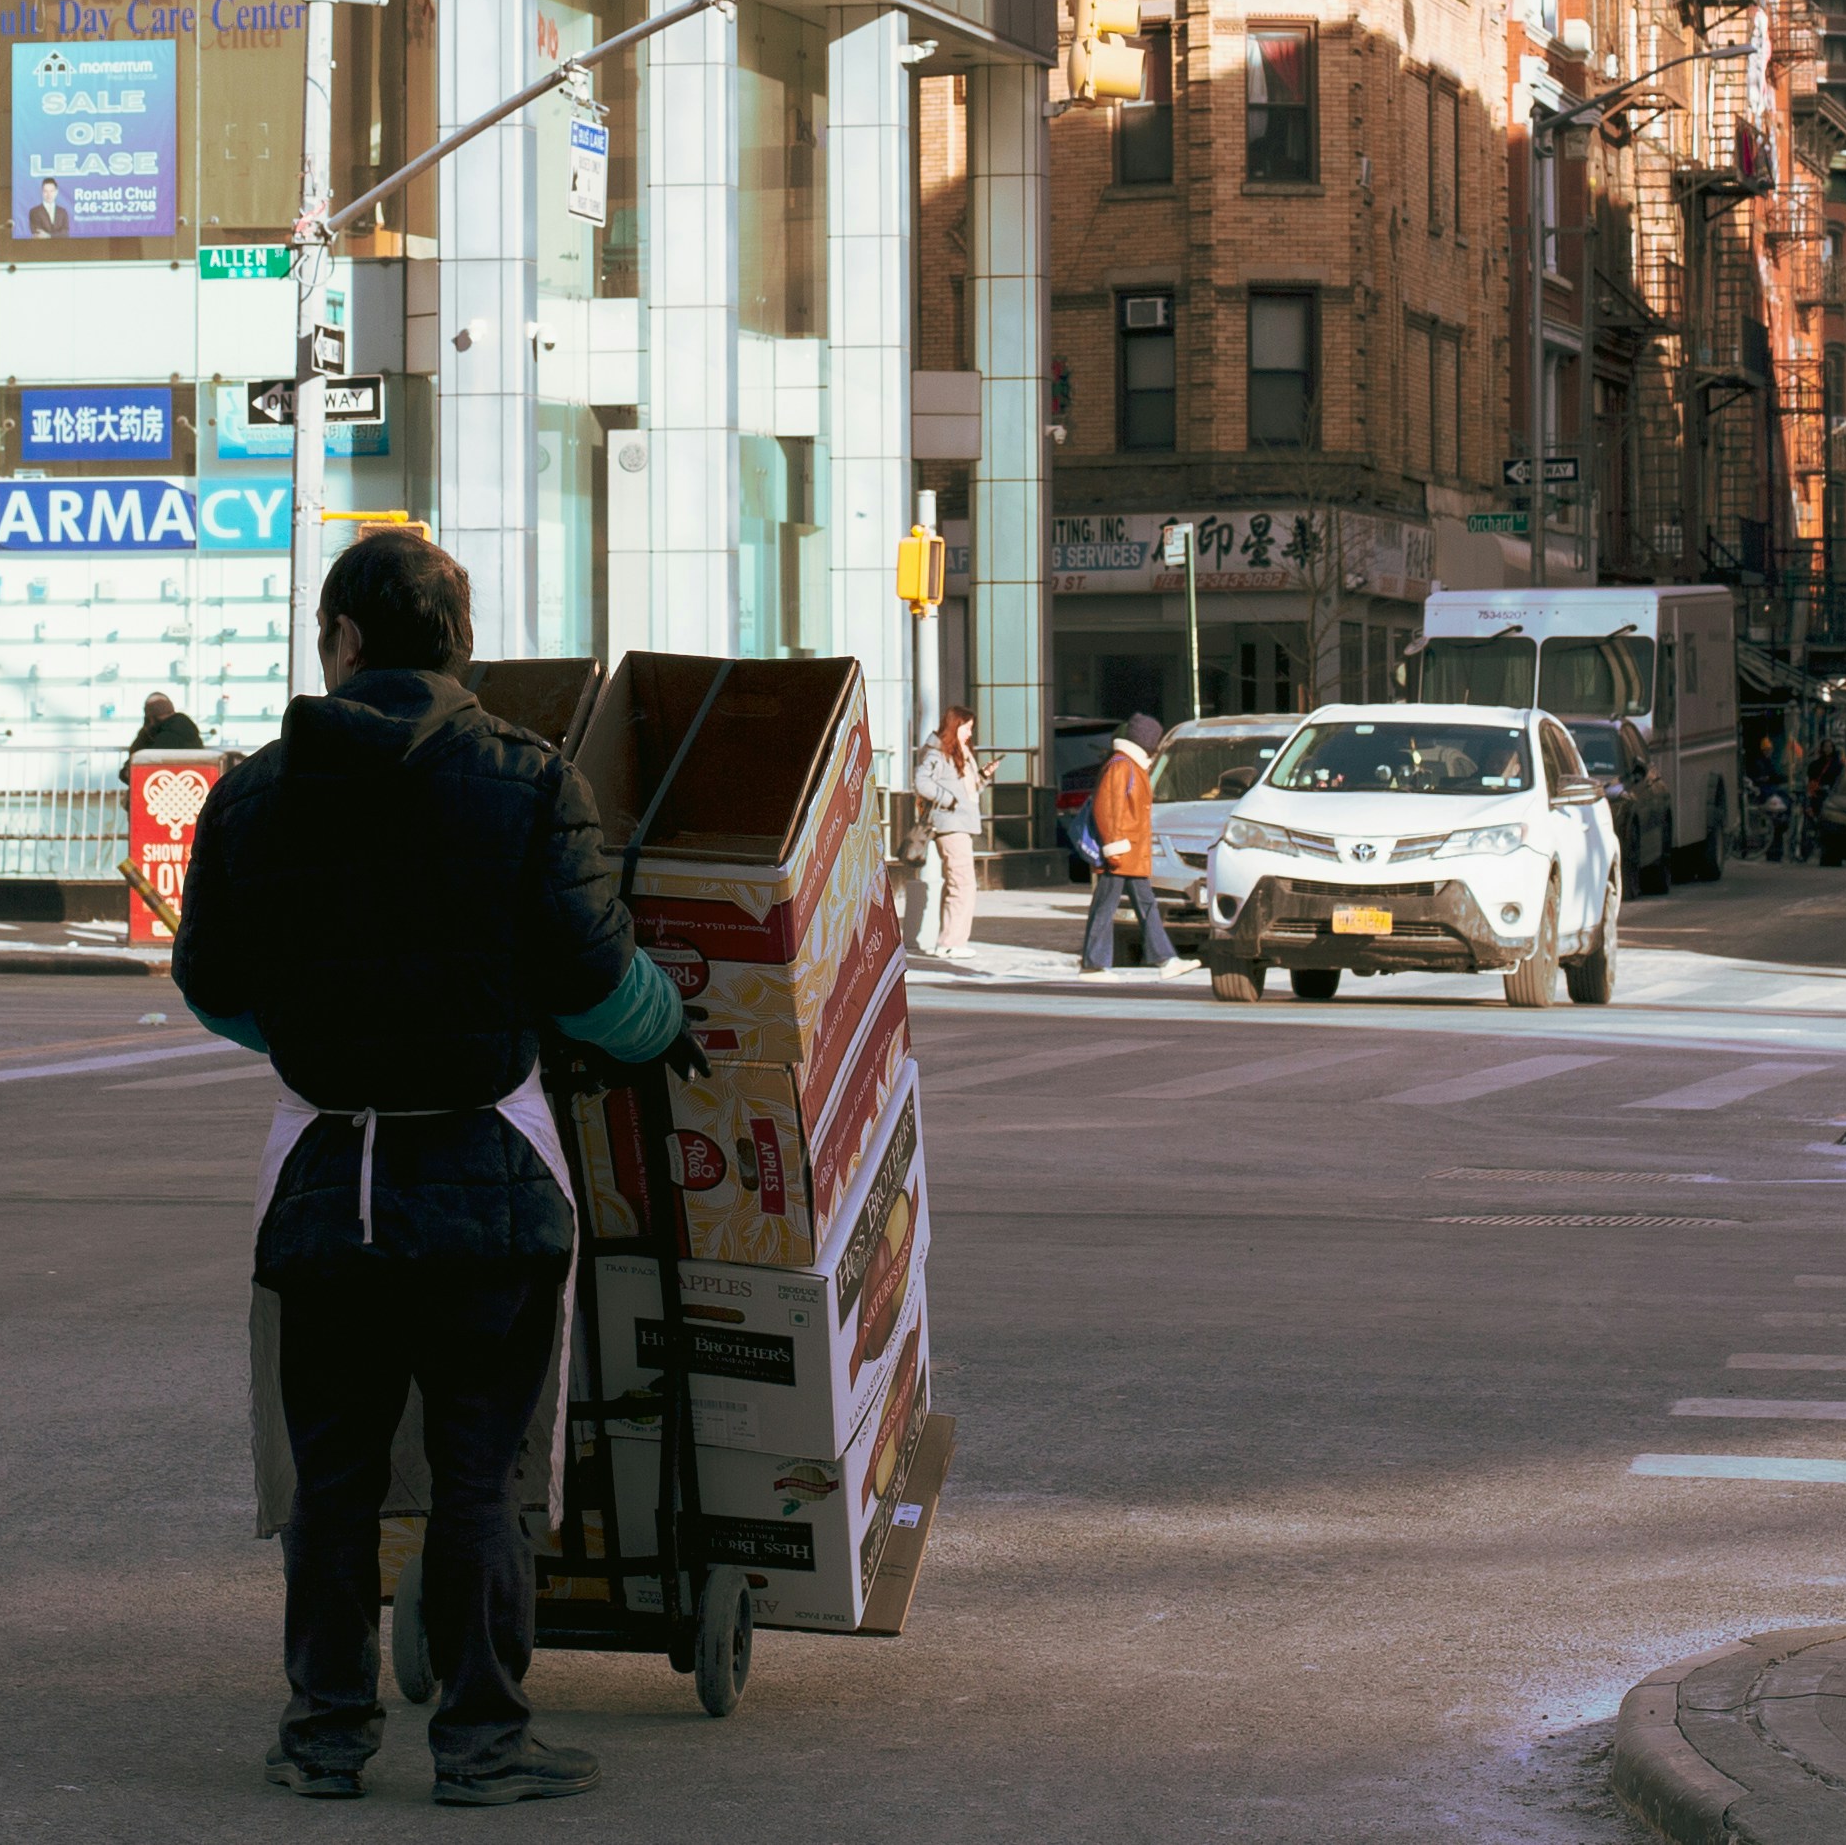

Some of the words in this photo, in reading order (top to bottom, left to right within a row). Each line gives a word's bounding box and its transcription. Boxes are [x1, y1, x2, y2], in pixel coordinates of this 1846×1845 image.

[59, 0, 113, 40] Day
[127, 0, 195, 35] Care
[42, 90, 146, 114] SALE
[66, 122, 122, 145] OR
[30, 151, 159, 176] LEASE
[74, 187, 122, 200] Ronald
[125, 186, 157, 200] Chui
[74, 201, 156, 214] 646-210-2768
[210, 248, 268, 267] ALLEN
[266, 393, 293, 412] ON
[31, 406, 164, 445] 亚伦街大药房
[1517, 466, 1531, 478] ON
[1052, 517, 1095, 544] TING,
[1100, 517, 1130, 542] INC.
[1469, 515, 1513, 532] Orchard
[1067, 545, 1141, 568] SERVICES
[142, 843, 184, 862] SHOW
[737, 924, 770, 934] PRODUCE
[685, 1139, 708, 1179] Rice
[759, 1142, 780, 1192] APPLES
[604, 1263, 629, 1274] TRAY
[837, 1226, 866, 1301] HESS
[679, 1273, 753, 1298] APPLES
[695, 1336, 791, 1363] BROTHER'S
[762, 1541, 809, 1559] HESS
